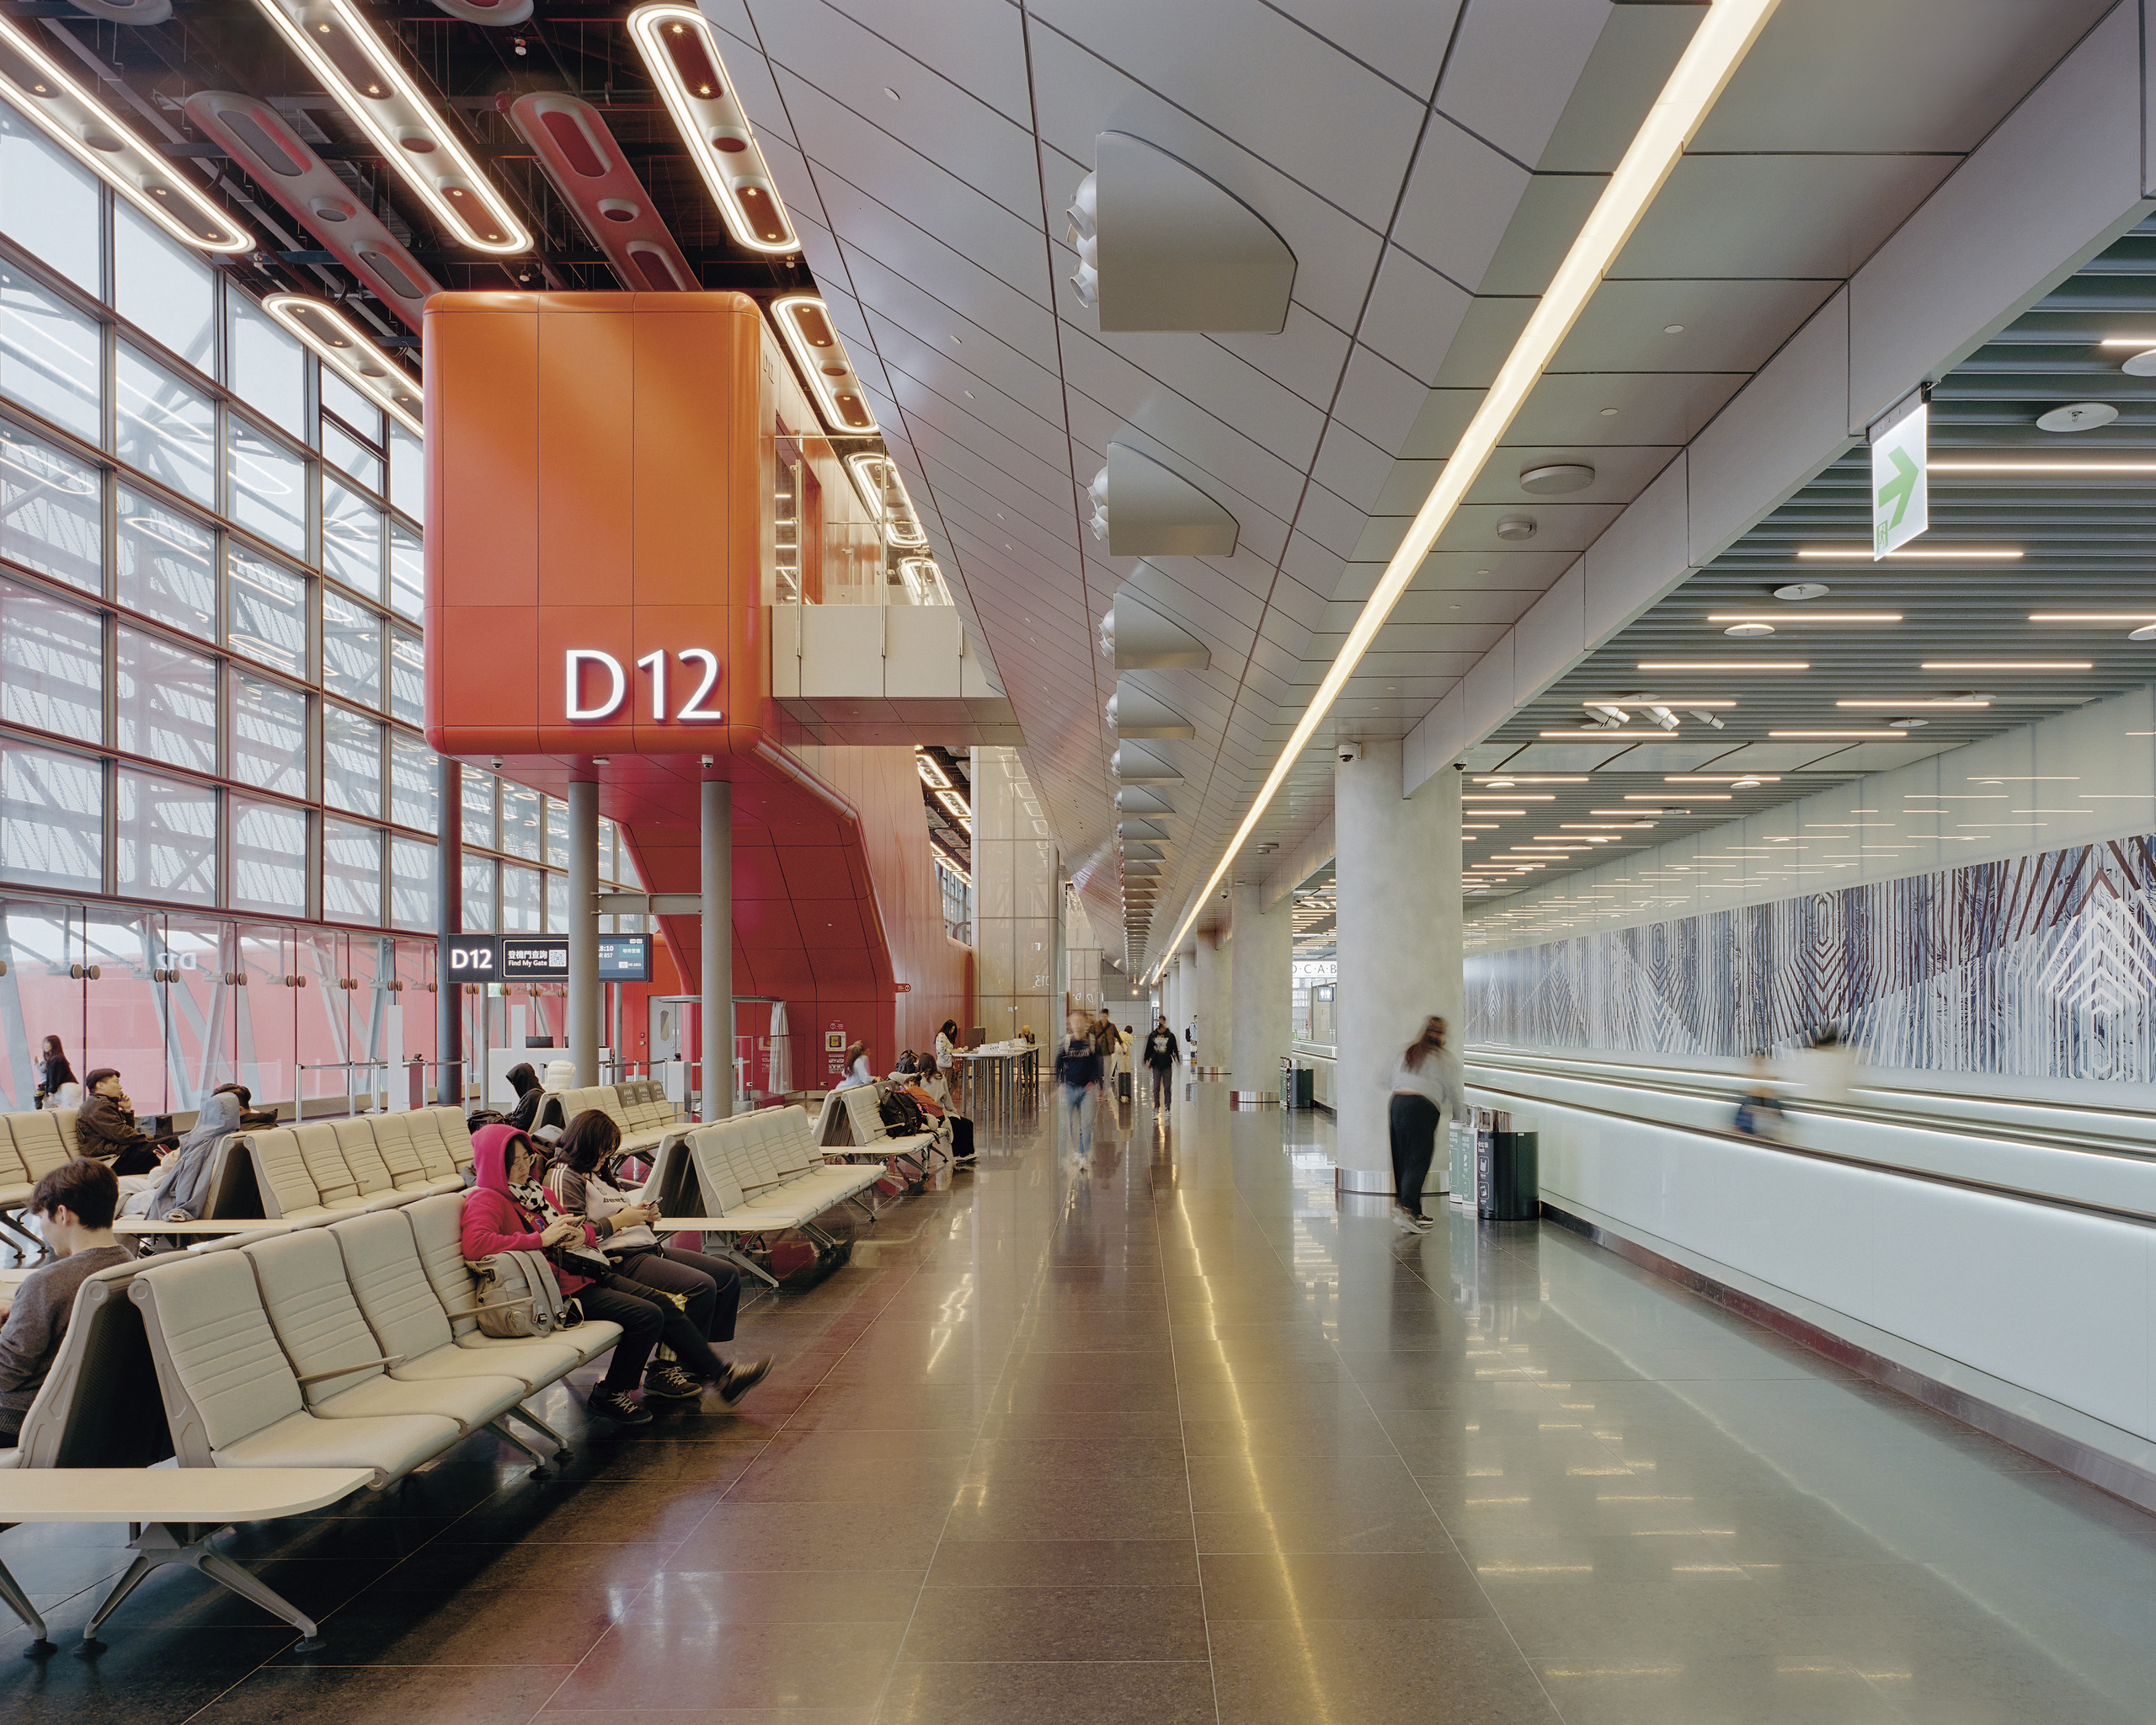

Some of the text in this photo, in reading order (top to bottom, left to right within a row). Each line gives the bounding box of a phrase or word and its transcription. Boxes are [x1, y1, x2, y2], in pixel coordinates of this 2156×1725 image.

[566, 648, 724, 721] D12
[451, 948, 493, 969] D12
[522, 959, 532, 968] My
